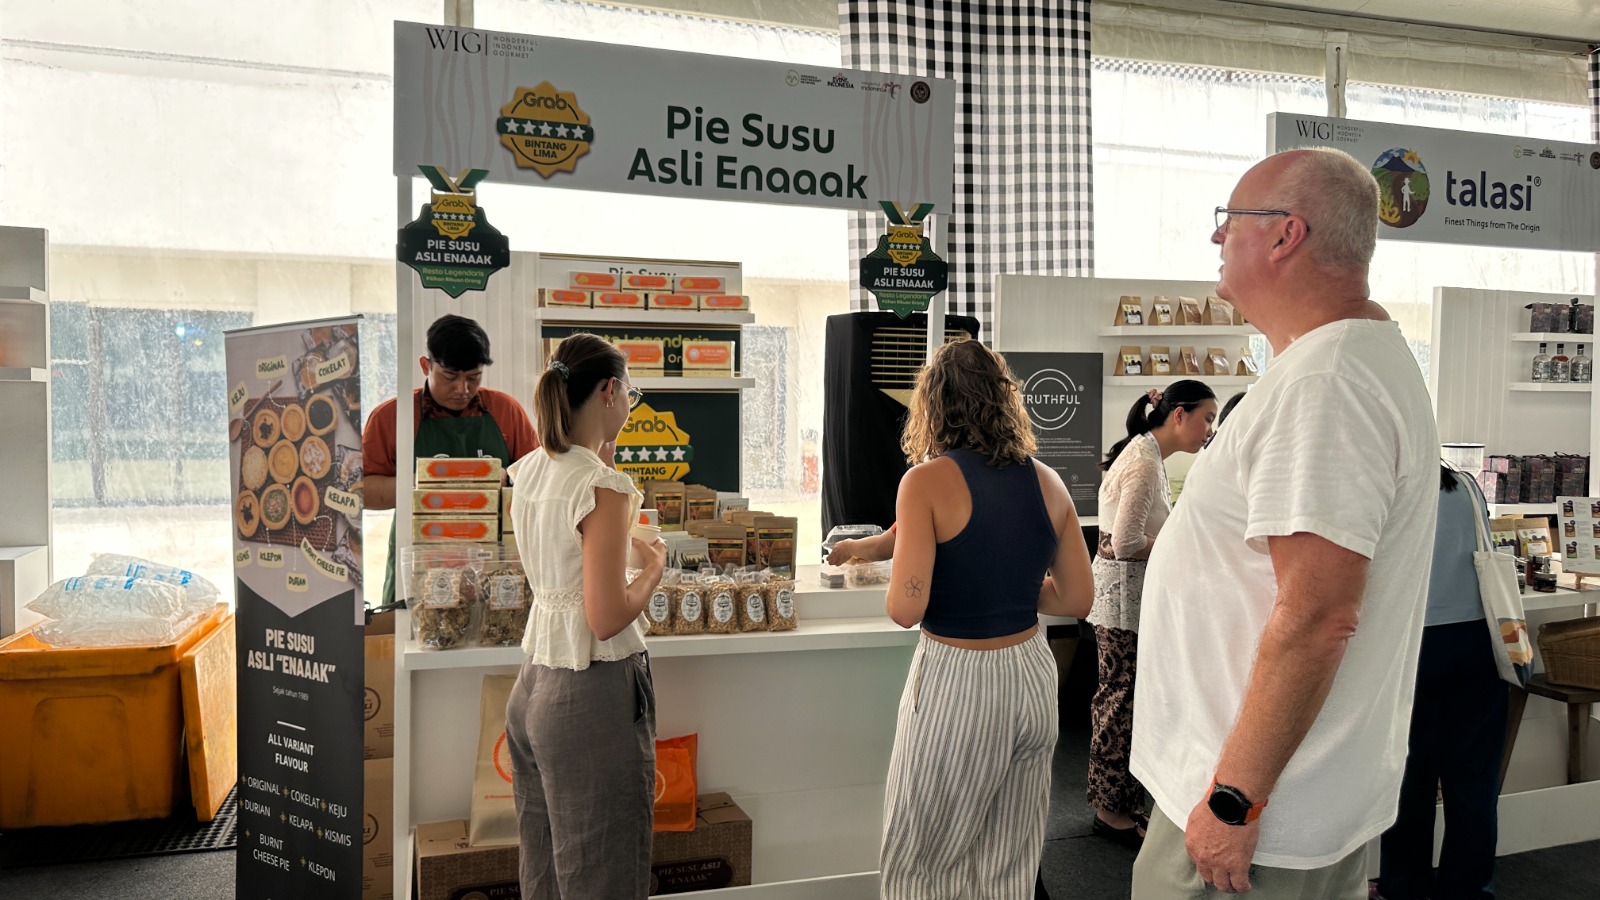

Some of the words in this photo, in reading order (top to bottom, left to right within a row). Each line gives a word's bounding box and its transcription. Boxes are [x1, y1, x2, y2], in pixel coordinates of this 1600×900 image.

[425, 28, 481, 54] WIG
[493, 36, 538, 45] WONDERFUL
[493, 44, 534, 53] INDONESIA
[493, 50, 530, 59] GOURMET
[523, 92, 568, 110] Grab
[667, 105, 730, 144] Pie
[742, 113, 835, 154] Susu
[1296, 120, 1330, 140] WIG
[525, 140, 567, 151] BINTANG
[533, 149, 557, 159] LIMA
[627, 147, 703, 186] Asli
[716, 155, 868, 200] Enaaak
[442, 199, 464, 207] Grab
[1445, 217, 1464, 226] Finest
[1466, 219, 1488, 229] Things
[1490, 220, 1505, 229] from
[1507, 222, 1518, 230] The
[1520, 223, 1540, 233] Origin
[427, 240, 446, 249] PIE
[448, 241, 480, 251] SUSU
[415, 252, 441, 261] ASLI
[444, 253, 492, 265] ENAAAK
[884, 267, 898, 276] PIE
[900, 268, 925, 277] SUSU
[874, 278, 894, 287] ASLI
[896, 279, 934, 288] ENAAAK
[258, 360, 285, 373] ORIGINAL
[319, 358, 346, 377] COKELAT
[328, 490, 356, 508] KELAPA
[260, 552, 282, 562] KLEPON
[317, 557, 335, 574] CHEESE
[336, 567, 345, 576] PIE
[288, 576, 306, 586] DURIAN
[265, 628, 285, 649] PIE
[287, 632, 315, 655] SUSU
[247, 650, 274, 671] ASLI
[276, 656, 336, 683] “ENAAAK”
[272, 686, 285, 696] Sejak
[285, 688, 298, 699] tahun
[298, 692, 309, 701] 1989
[268, 733, 282, 747] ALL
[283, 737, 314, 756] VARIANT
[275, 752, 309, 773] FLAVOUR
[247, 776, 280, 796] ORIGINAL
[290, 789, 320, 809] COKELAT
[328, 802, 347, 818] KEJU
[244, 800, 271, 817] DURIAN
[289, 814, 314, 832] KELAPA
[325, 828, 352, 847] KISMIS
[259, 833, 284, 851] BURNT
[253, 848, 279, 867] CHEESE
[279, 855, 290, 871] PIE
[659, 867, 673, 876] PIE
[700, 861, 721, 870] ASLI
[308, 860, 336, 882] KLEPON
